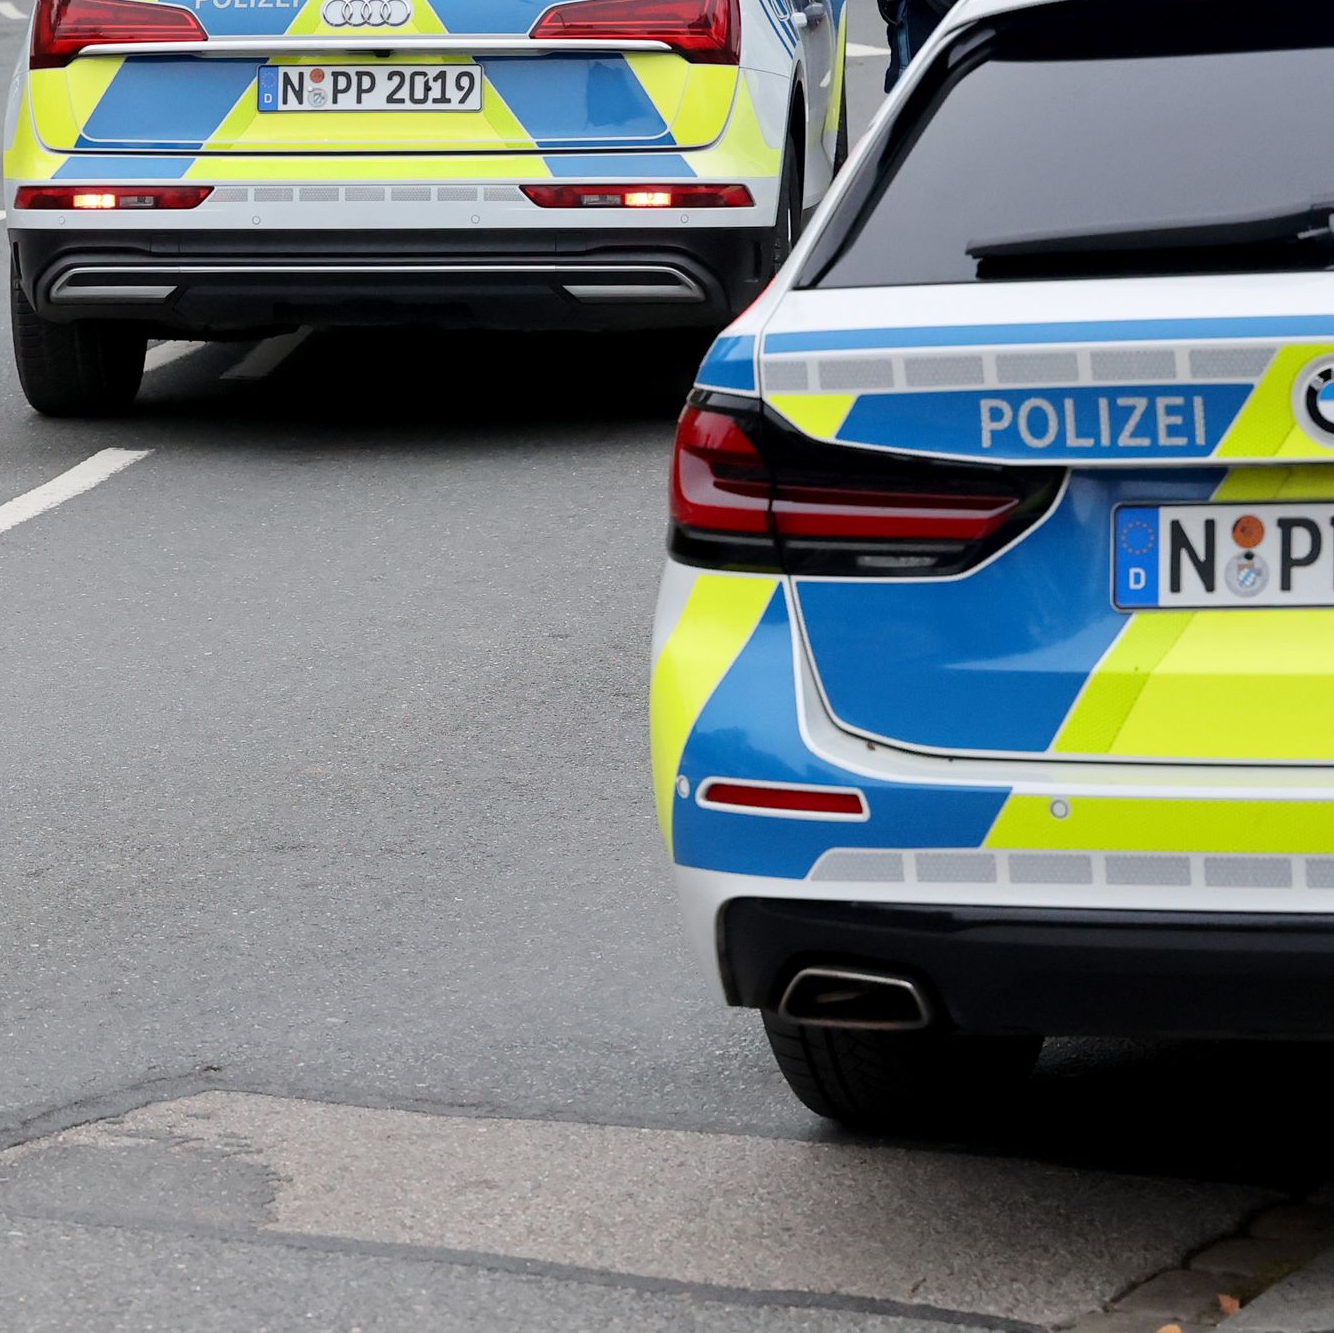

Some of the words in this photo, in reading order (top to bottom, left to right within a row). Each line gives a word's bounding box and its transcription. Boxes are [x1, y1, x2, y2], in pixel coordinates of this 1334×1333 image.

[282, 71, 304, 105] N
[331, 70, 376, 104] PP
[386, 70, 476, 105] 2019
[979, 396, 1206, 448] POLIZEI
[1170, 519, 1215, 593] N
[1129, 568, 1146, 590] D
